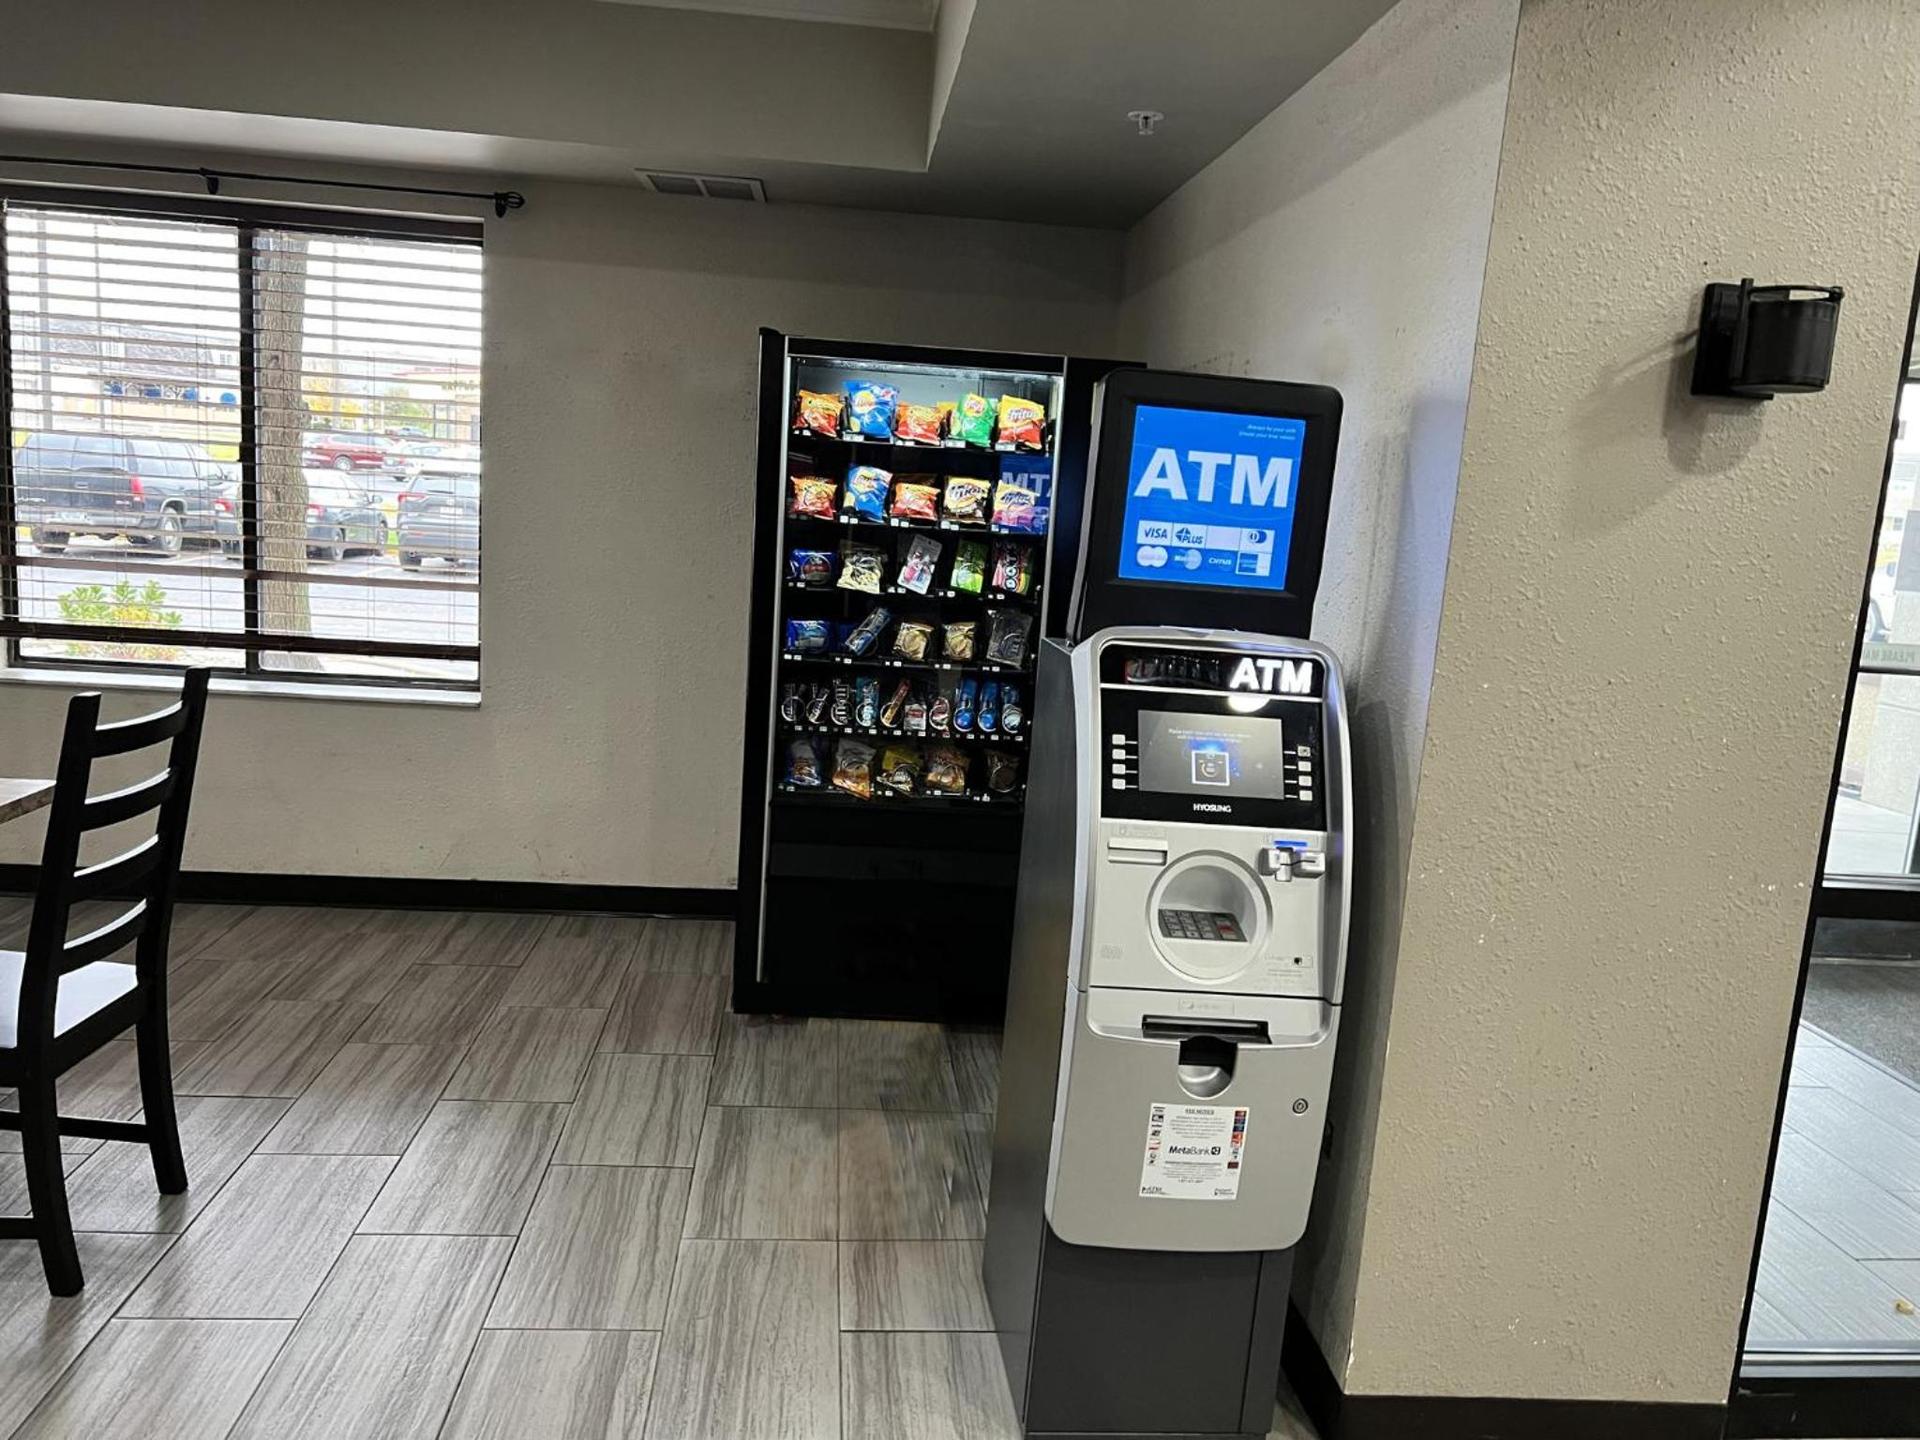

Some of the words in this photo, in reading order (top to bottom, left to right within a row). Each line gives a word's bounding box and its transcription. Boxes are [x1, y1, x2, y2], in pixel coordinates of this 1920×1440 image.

[1133, 447, 1293, 508] ATM
[1144, 527, 1168, 539] VISA
[1182, 535, 1203, 545] PLUS
[1229, 657, 1313, 694] ATM
[1193, 803, 1232, 813] HYOSUNG
[1169, 1145, 1211, 1156] MetaBank
